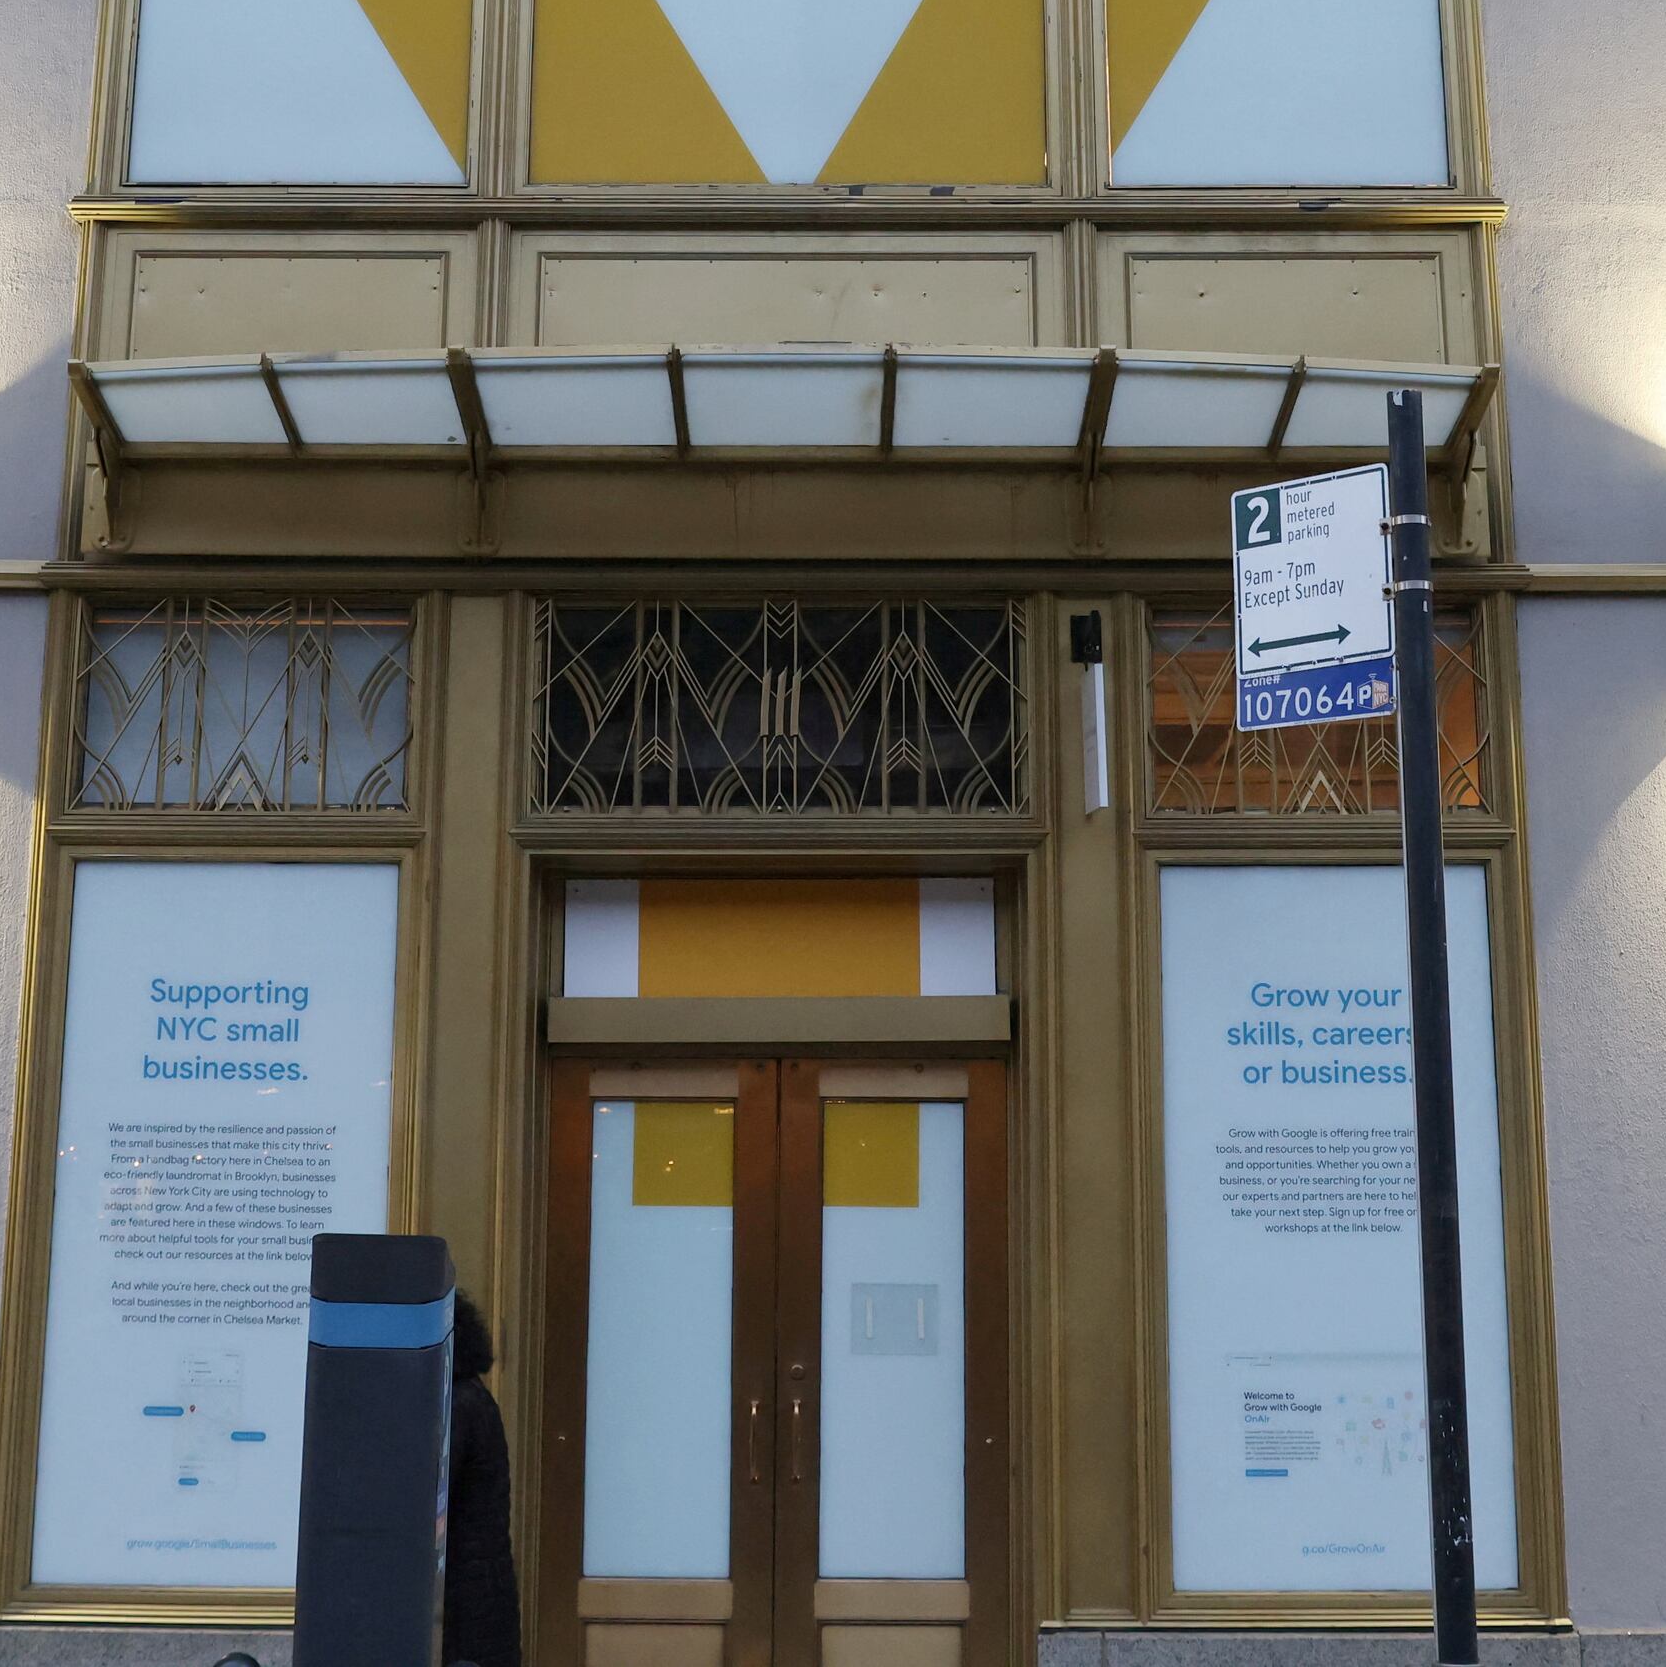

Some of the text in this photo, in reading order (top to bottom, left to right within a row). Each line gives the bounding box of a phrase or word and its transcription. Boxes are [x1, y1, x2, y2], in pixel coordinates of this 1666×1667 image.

[1247, 490, 1311, 543] 2 hour
[1287, 502, 1334, 523] metered
[1288, 524, 1330, 544] parking
[1244, 570, 1272, 586] 9am
[1287, 562, 1315, 580] 7pm
[1245, 579, 1344, 608] Except Sunday
[1244, 675, 1281, 687] Zone#
[1359, 684, 1371, 705] P
[1373, 692, 1389, 708] NYC
[1245, 682, 1354, 722] 107064
[150, 978, 308, 1011] Supporting
[1252, 982, 1402, 1013] Grow your
[157, 1017, 299, 1042] NYC small
[1227, 1021, 1303, 1048] skills,
[144, 1055, 308, 1081] businesses.
[1244, 1060, 1413, 1084] or business.
[108, 1122, 125, 1132] We
[144, 1123, 183, 1135] inspired
[184, 1123, 198, 1136] by
[199, 1123, 216, 1133] the
[217, 1124, 264, 1134] resilience
[265, 1124, 285, 1134] and
[286, 1124, 324, 1137] passion
[325, 1125, 337, 1134] of
[1228, 1128, 1392, 1140] Grow with Google is offering free
[110, 1138, 301, 1152] the small businesses that make this city
[1215, 1144, 1398, 1156] tools, and resources to help you grow
[1225, 1159, 1245, 1169] and
[1246, 1159, 1315, 1172] opportunities.
[1316, 1159, 1359, 1169] Whether
[1361, 1162, 1380, 1172] you
[1219, 1175, 1265, 1186] business,
[1280, 1175, 1311, 1187] you're
[1312, 1175, 1361, 1187] searching
[1362, 1175, 1377, 1185] for
[1379, 1178, 1401, 1187] your
[1241, 1191, 1280, 1203] experts
[1280, 1191, 1301, 1201] and
[1302, 1191, 1345, 1203] partners
[1364, 1191, 1387, 1201] here
[1388, 1191, 1400, 1201] to
[1230, 1207, 1405, 1219] take your next step. Sign up for free
[1264, 1222, 1402, 1235] workshops at the link below.
[111, 1281, 289, 1294] And while you're here, check out the
[112, 1297, 295, 1311] local businesses in the neighborhood
[121, 1313, 301, 1325] around the corner in Chelsea Market.
[1244, 1391, 1294, 1400] Welcome to
[1245, 1403, 1322, 1414] Grow with Google
[1245, 1415, 1269, 1424] OnAir
[1302, 1543, 1385, 1556] g.co/GrowOnAir
